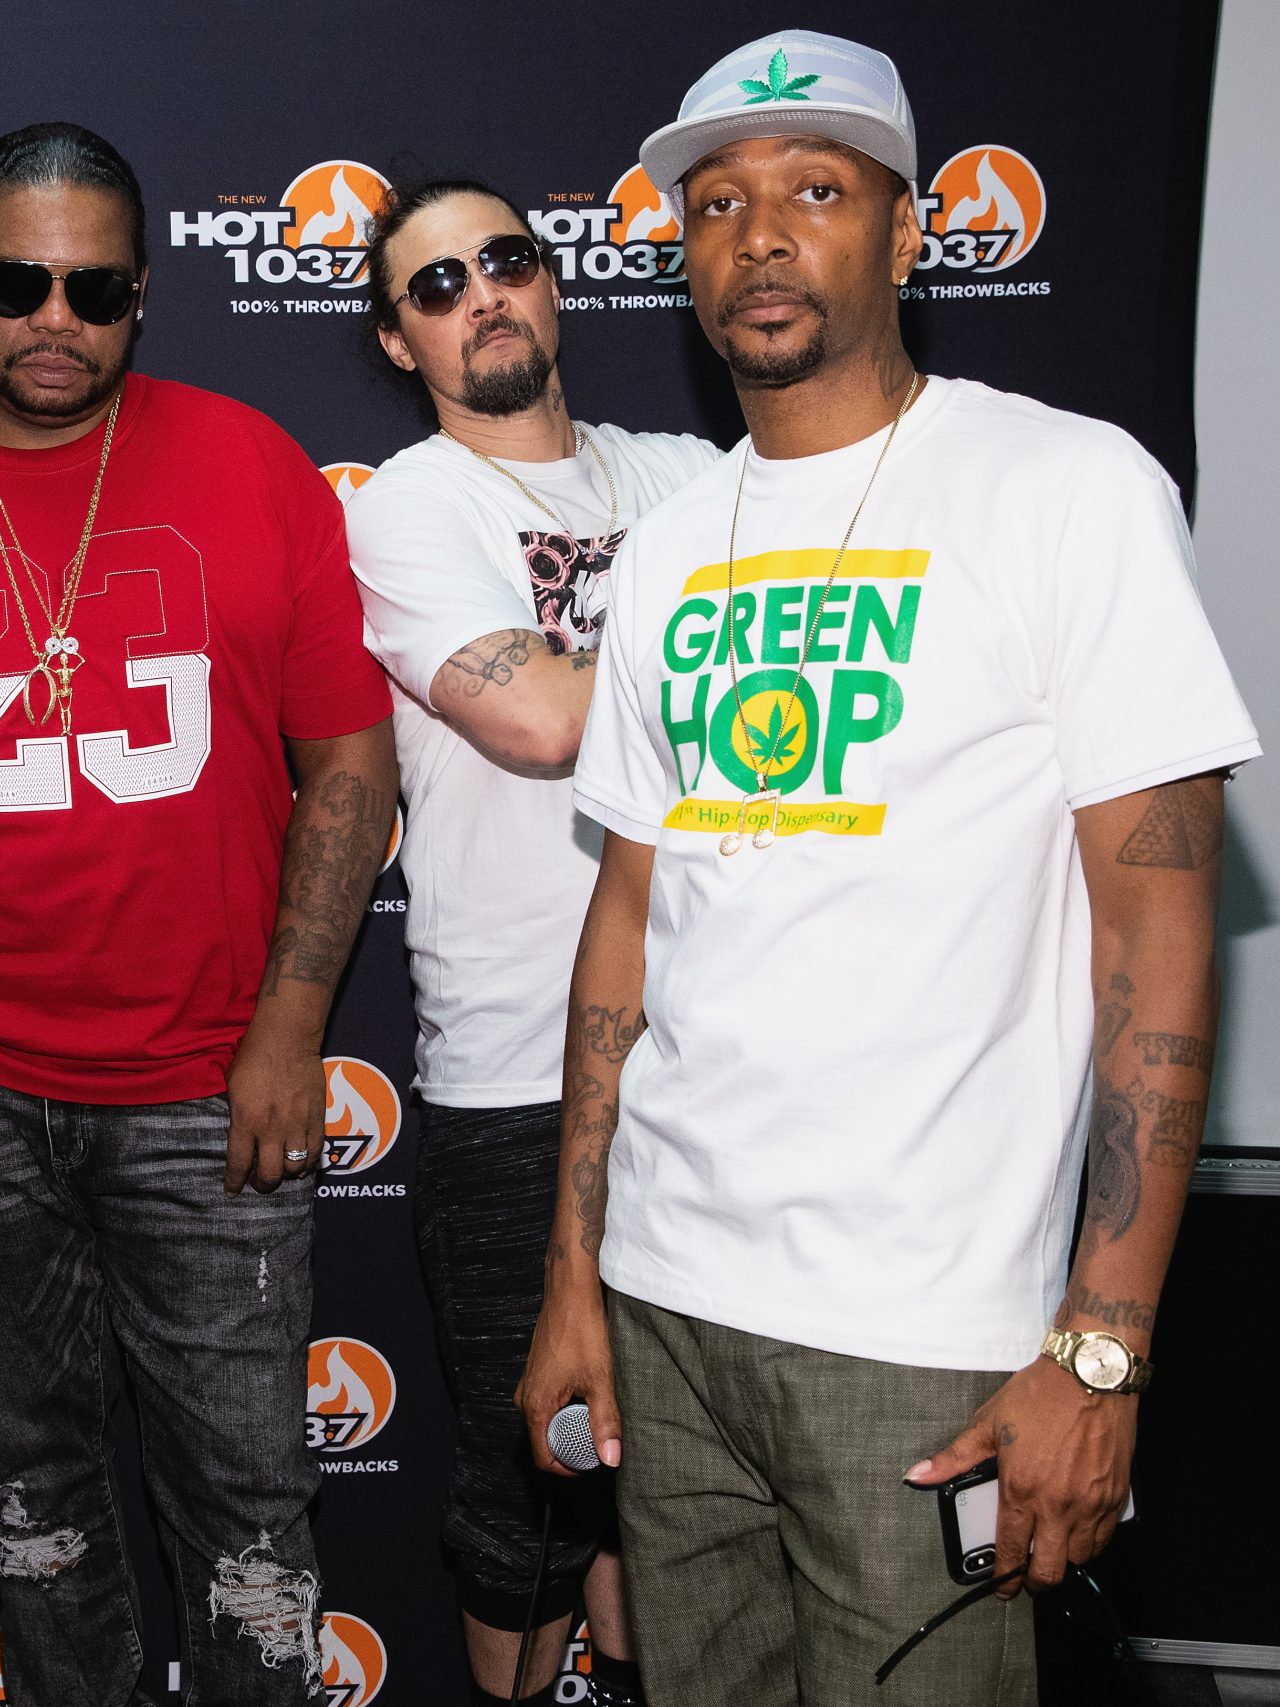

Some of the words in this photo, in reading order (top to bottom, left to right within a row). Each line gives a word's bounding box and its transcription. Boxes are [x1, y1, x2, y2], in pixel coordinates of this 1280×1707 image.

[218, 195, 238, 204] THE
[241, 195, 267, 204] NEW
[547, 193, 567, 202] THE
[570, 193, 595, 201] NEW
[170, 211, 291, 246] HOT
[914, 233, 1010, 270] 03.7
[929, 282, 1051, 299] THROWBACKS
[230, 300, 279, 313] 100%
[663, 585, 922, 674] GREEN
[660, 669, 904, 797] HOP
[316, 1184, 406, 1198] OWBACKS
